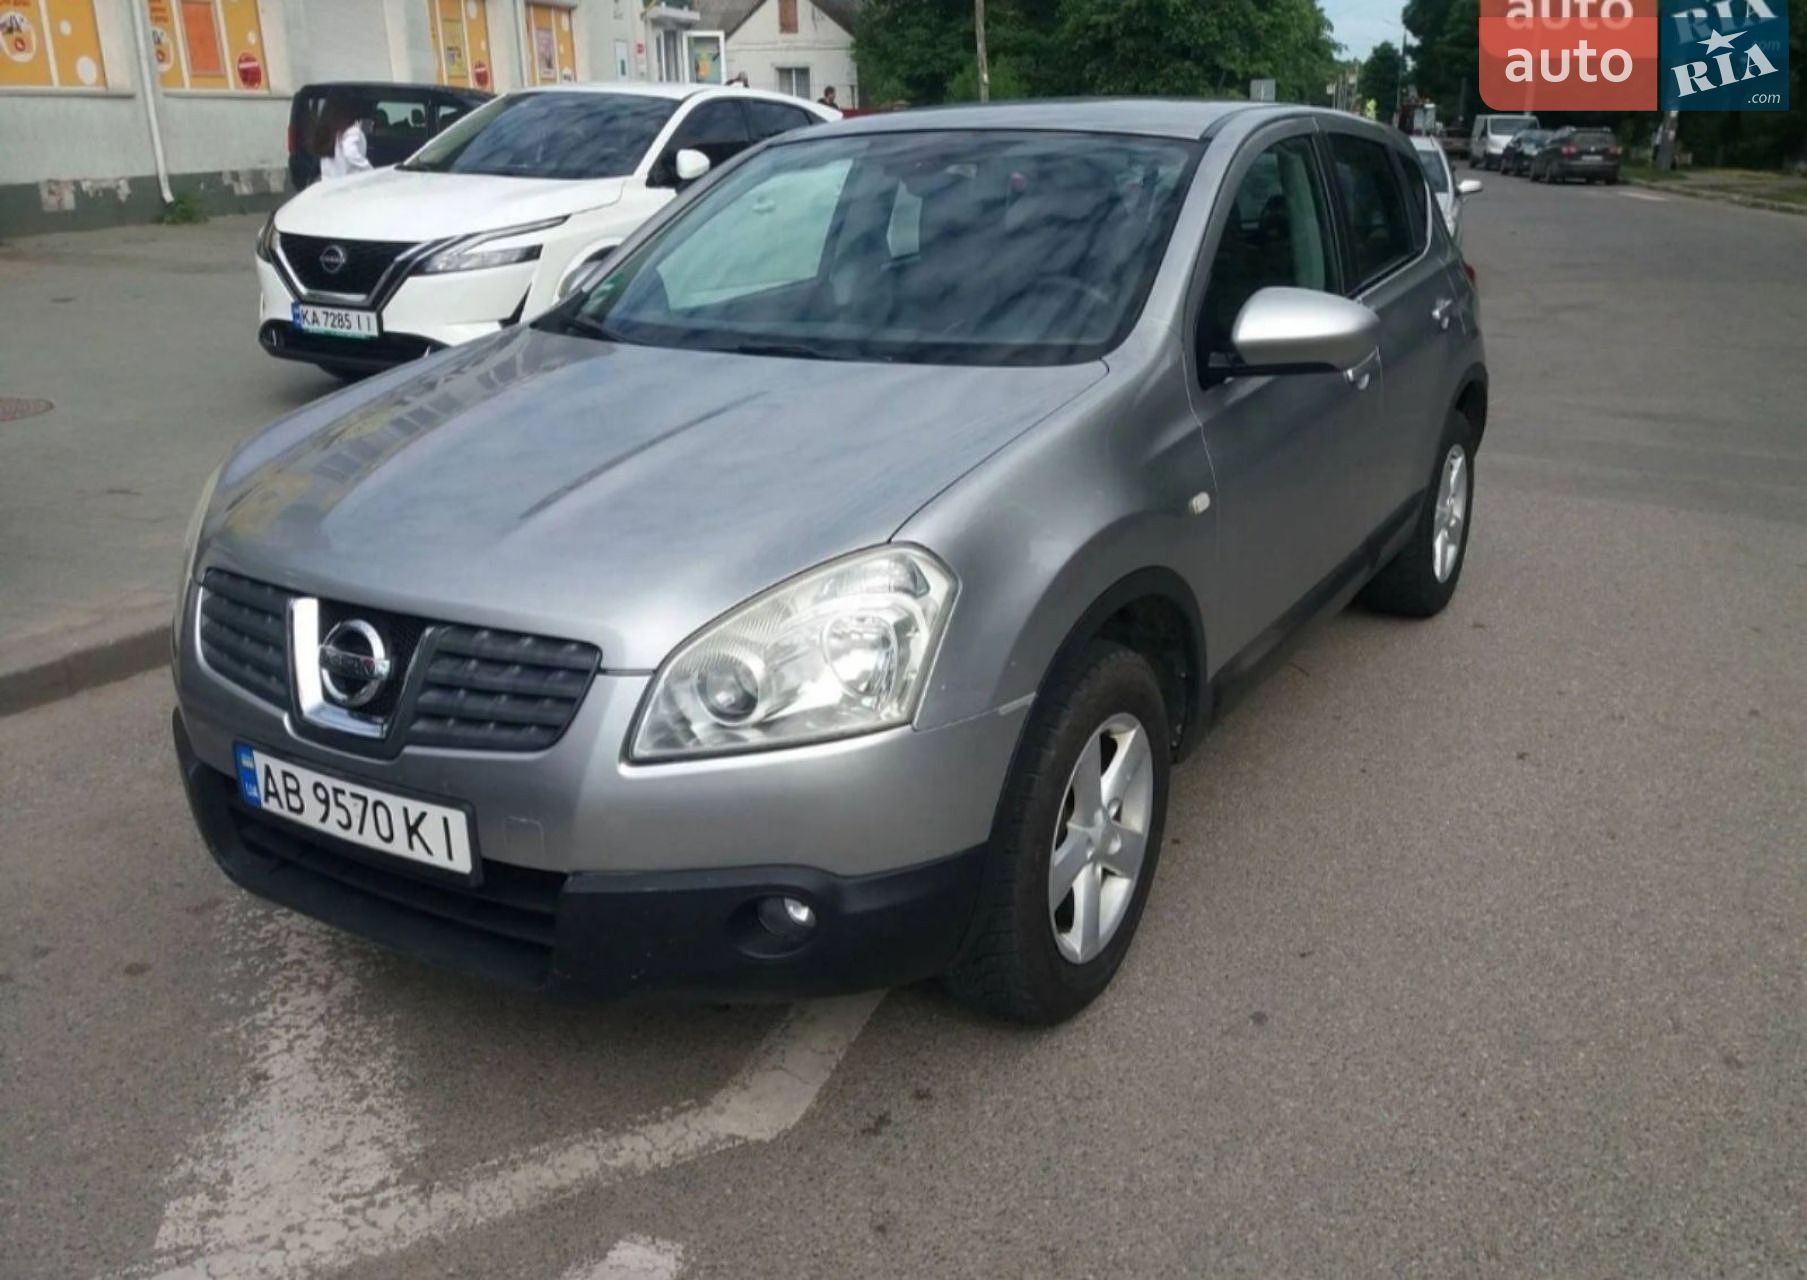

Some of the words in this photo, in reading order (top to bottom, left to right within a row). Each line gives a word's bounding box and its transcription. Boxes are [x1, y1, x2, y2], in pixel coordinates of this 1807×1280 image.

[301, 308, 320, 327] KA
[322, 310, 352, 330] 7285
[264, 764, 304, 815] AB
[312, 781, 394, 844] 9570
[403, 806, 453, 861] KI
